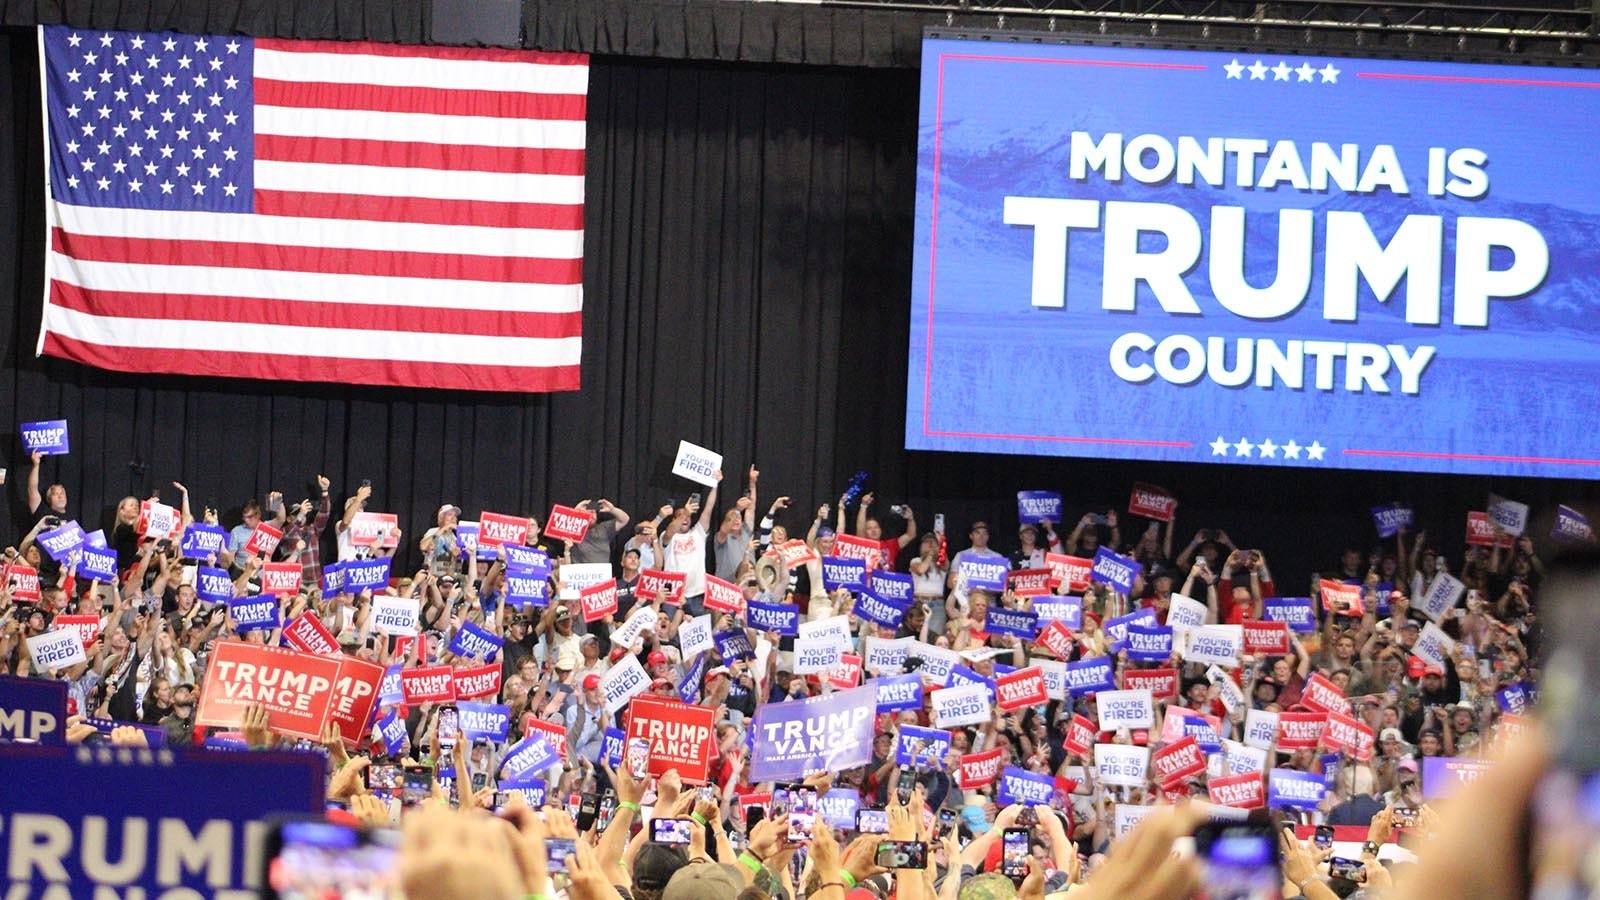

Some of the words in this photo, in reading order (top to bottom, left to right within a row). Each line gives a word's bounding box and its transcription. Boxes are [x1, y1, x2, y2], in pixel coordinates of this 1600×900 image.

[1069, 131, 1410, 196] MONTANA
[1427, 147, 1489, 199] IS
[1003, 196, 1550, 327] TRUMP
[1109, 332, 1436, 394] COUNTRY
[23, 429, 64, 440] TRUMP
[28, 436, 60, 445] VANCE
[685, 453, 715, 468] YOU'RE
[1021, 498, 1061, 507] TRUMP
[484, 520, 526, 533] TRUMP
[553, 513, 589, 527] TRUMP
[555, 521, 583, 533] VANCE
[44, 528, 79, 547] TRUMP
[196, 531, 223, 542] TRUMP
[487, 528, 520, 541] VANCE
[52, 535, 81, 552] VANCE
[836, 541, 879, 556] TRUMP
[84, 551, 115, 566] TRUMP
[507, 547, 547, 563] TRUMP
[511, 555, 544, 568] VANCE
[87, 560, 112, 571] VANCE
[348, 565, 388, 576] TRUMP
[824, 564, 865, 574] TRUMP
[961, 566, 1007, 578] TRUMP
[1048, 560, 1091, 575] TRUMP
[265, 571, 301, 580] TRUMP
[353, 573, 383, 583] VANCE
[828, 573, 861, 582] VANCE
[965, 575, 1001, 585] VANCE
[1009, 574, 1050, 584] TRUMP
[1094, 564, 1131, 587] TRUMP
[270, 579, 297, 587] VANCE
[509, 578, 545, 588] TRUMP
[872, 576, 911, 590] TRUMP
[513, 585, 542, 596] VANCE
[876, 584, 906, 597] VANCE
[233, 602, 274, 614] TRUMP
[861, 592, 902, 616] TRUMP
[864, 600, 895, 621] VANCE
[1033, 604, 1079, 612] TRUMP
[1266, 606, 1309, 615] TRUMP
[237, 610, 271, 621] VANCE
[381, 608, 412, 617] YOU'RE
[749, 606, 796, 624] TRUMP
[989, 612, 1035, 625] TRUMP
[1037, 611, 1073, 620] VANCE
[1272, 614, 1307, 622] VANCE
[375, 615, 415, 632] FIRED!
[754, 616, 790, 630] VANCE
[994, 618, 1031, 629] VANCE
[299, 617, 333, 657] TRUMP
[808, 627, 841, 638] YOU'RE
[1128, 633, 1171, 643] TRUMP
[1244, 628, 1284, 638] TRUMP
[37, 638, 73, 653] YOU'RE
[295, 624, 322, 655] VANCE
[461, 629, 497, 653] TRUMP
[1132, 641, 1166, 650] VANCE
[1197, 636, 1233, 647] YOU'RE
[1248, 638, 1281, 646] VANCE
[37, 645, 80, 665] FIRED!
[803, 647, 836, 656] YOU'RE
[874, 648, 907, 656] YOU'RE
[1192, 645, 1235, 657] FIRED!
[799, 654, 838, 666] FIRED!
[217, 661, 329, 697] TRUMP
[455, 671, 500, 688] TRUMP
[604, 665, 635, 691] YOU'RE
[1065, 666, 1109, 680] TRUMP
[404, 674, 451, 688] TRUMP
[607, 671, 644, 703] FIRED!
[998, 676, 1041, 695] TRUMP
[1068, 676, 1105, 688] VANCE
[1126, 676, 1173, 686] TRUMP
[409, 684, 447, 695] VANCE
[460, 682, 495, 695] VANCE
[1003, 687, 1038, 701] VANCE
[224, 681, 312, 711] VANCE
[941, 695, 979, 707] YOU'RE
[939, 703, 984, 719] FIRED!
[1107, 701, 1144, 709] YOU'RE
[460, 708, 507, 726] TRUMP
[1104, 710, 1147, 720] FIRED!
[464, 719, 501, 731] VANCE
[763, 706, 869, 742] TRUMP
[1280, 721, 1323, 731] TRUMP
[634, 718, 709, 744] TRUMP
[651, 737, 700, 758] ANCE
[774, 727, 858, 755] VANCE
[787, 752, 817, 760] AMERICA
[1156, 744, 1197, 769] TRUMP
[962, 760, 1001, 777] TRUMP
[1161, 754, 1196, 774] VANCE
[1100, 766, 1142, 776] FIRED!
[1005, 776, 1053, 792] TRUMP
[1212, 780, 1260, 795] TRUMP
[1273, 778, 1323, 791] TRUMP
[1009, 786, 1045, 800] VANCE
[1220, 790, 1257, 804] VANCE
[1278, 789, 1319, 799] VANCE
[0, 812, 266, 888] RUM
